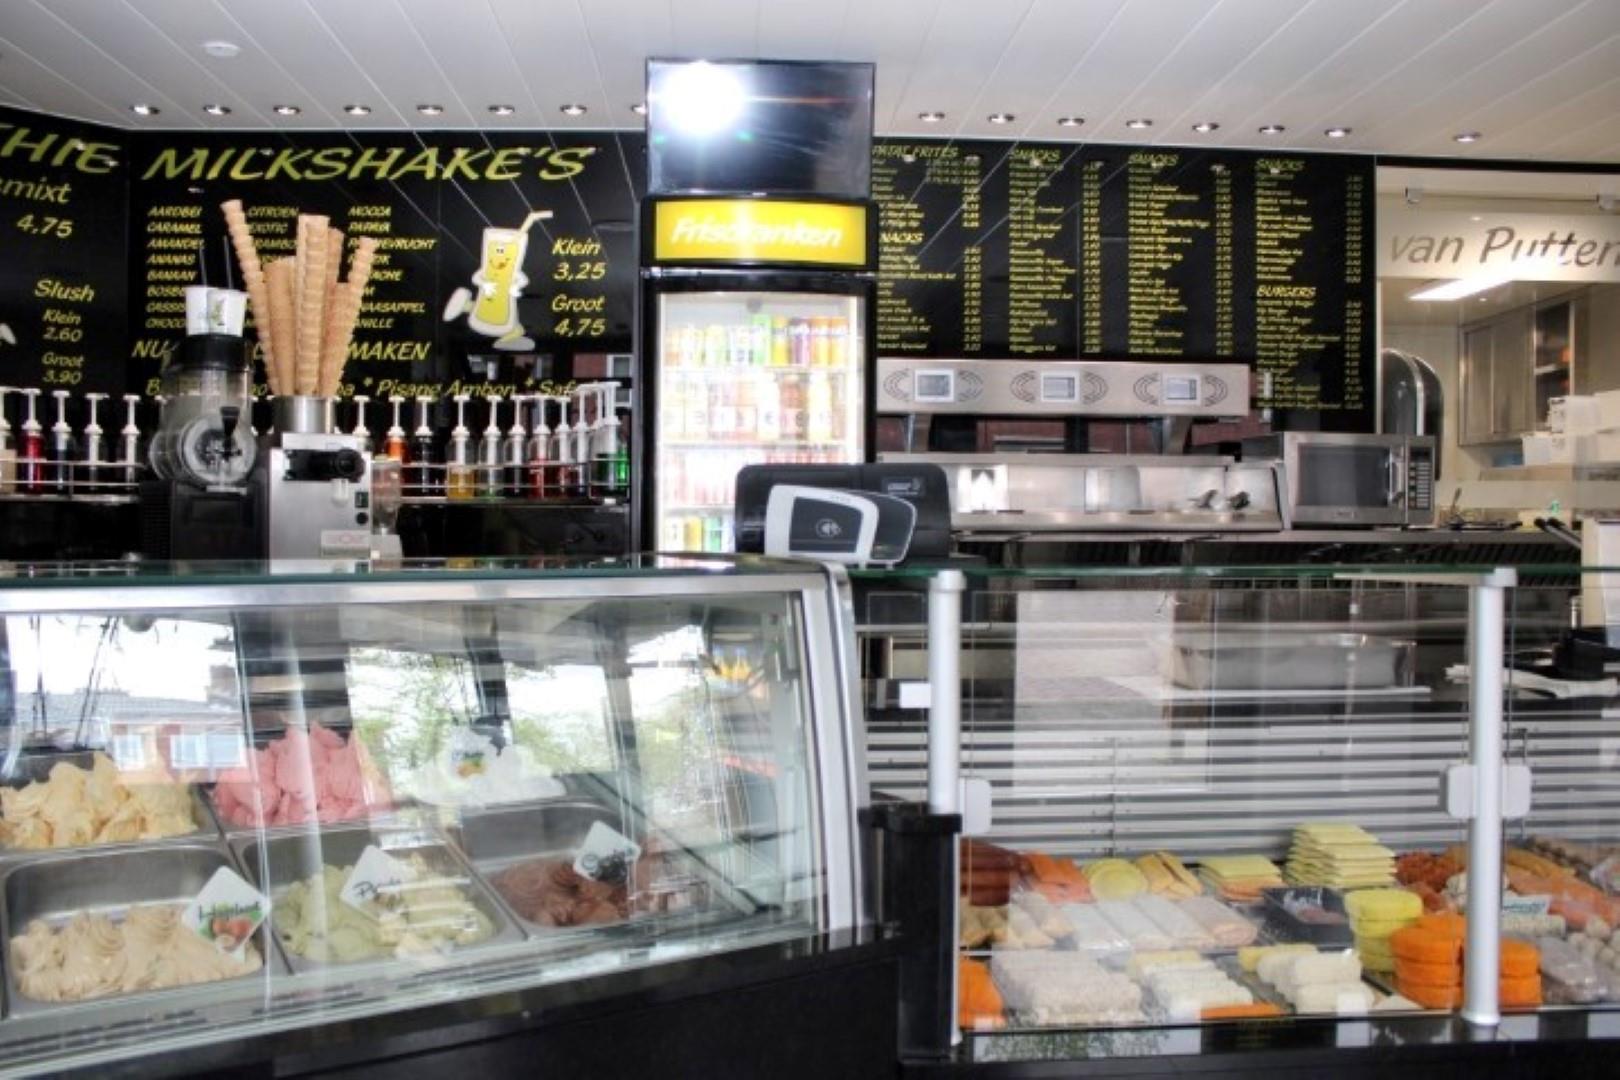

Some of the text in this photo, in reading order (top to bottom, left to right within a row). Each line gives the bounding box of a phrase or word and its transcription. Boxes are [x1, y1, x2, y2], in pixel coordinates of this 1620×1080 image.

[0, 123, 121, 174] HIE
[142, 146, 597, 182] MILKSHAKE'S
[0, 176, 72, 204] mixt
[879, 232, 925, 245] NACKS
[1391, 235, 1465, 264] van
[34, 279, 95, 302] Slush
[1256, 285, 1317, 298] BURGERS
[552, 295, 605, 312] Groot
